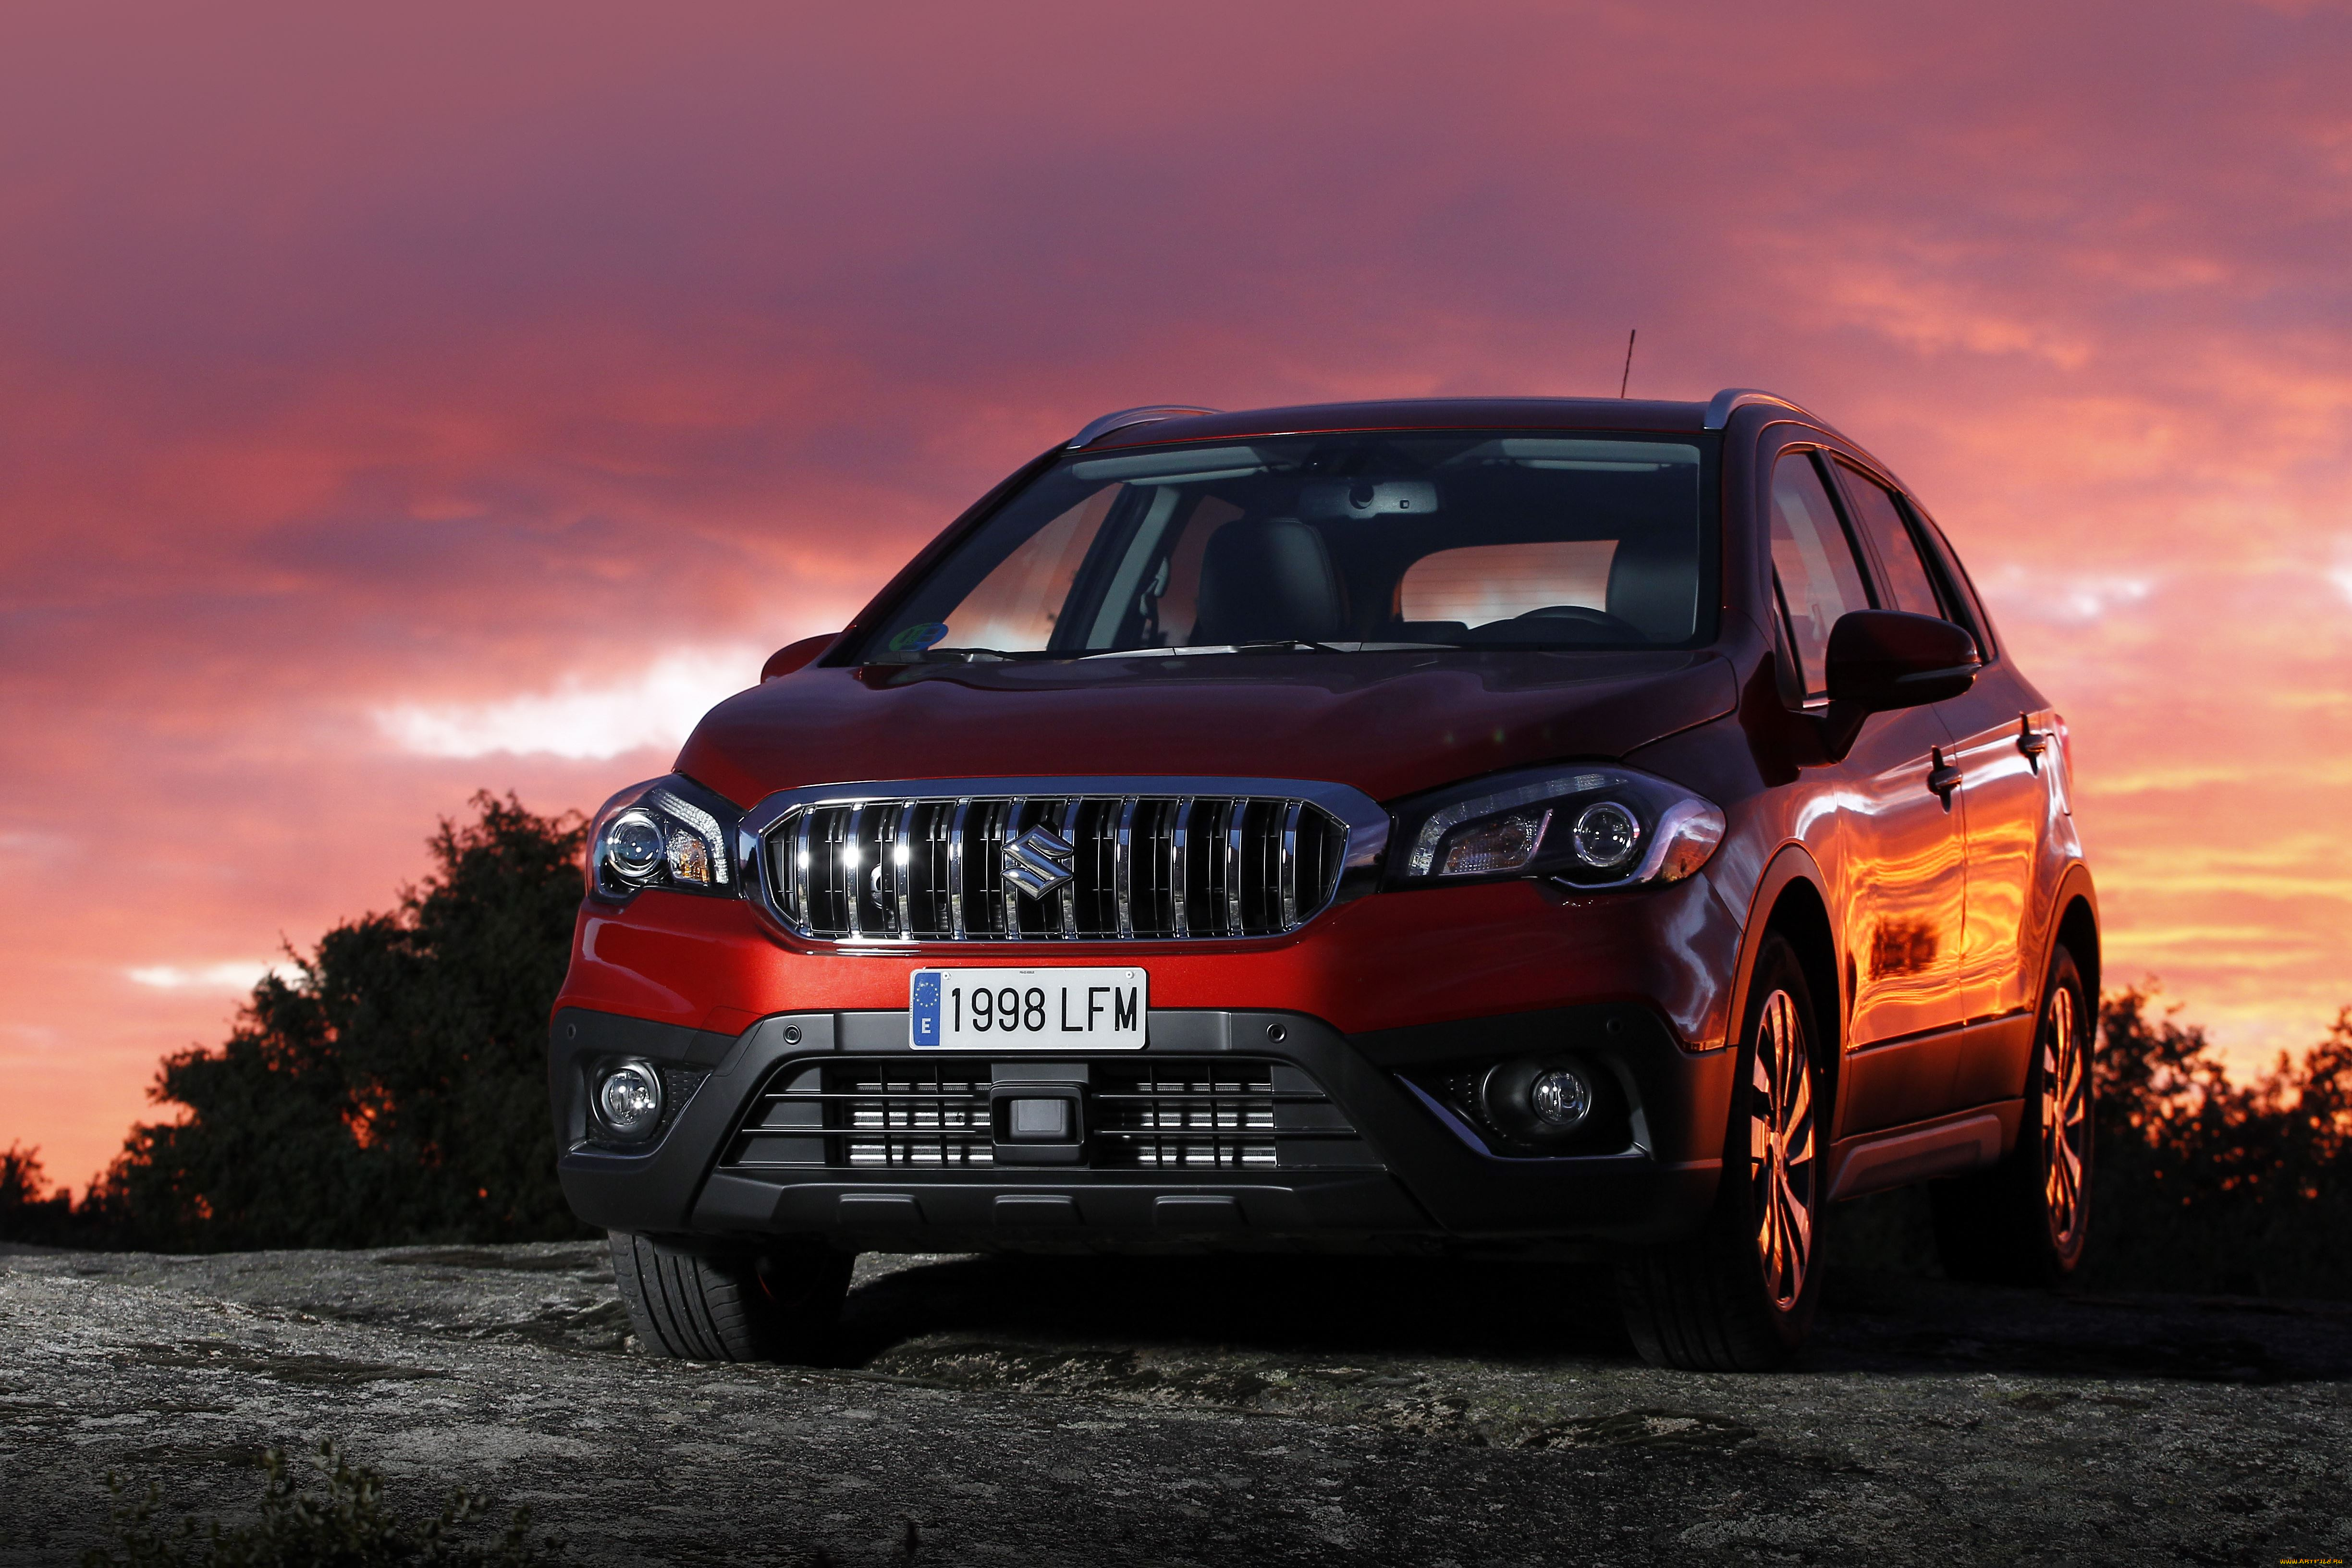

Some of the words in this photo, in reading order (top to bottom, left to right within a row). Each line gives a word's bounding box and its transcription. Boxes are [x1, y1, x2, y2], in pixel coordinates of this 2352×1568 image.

[952, 987, 1045, 1032] 1998
[1061, 987, 1137, 1031] LFM
[921, 1017, 931, 1034] E
